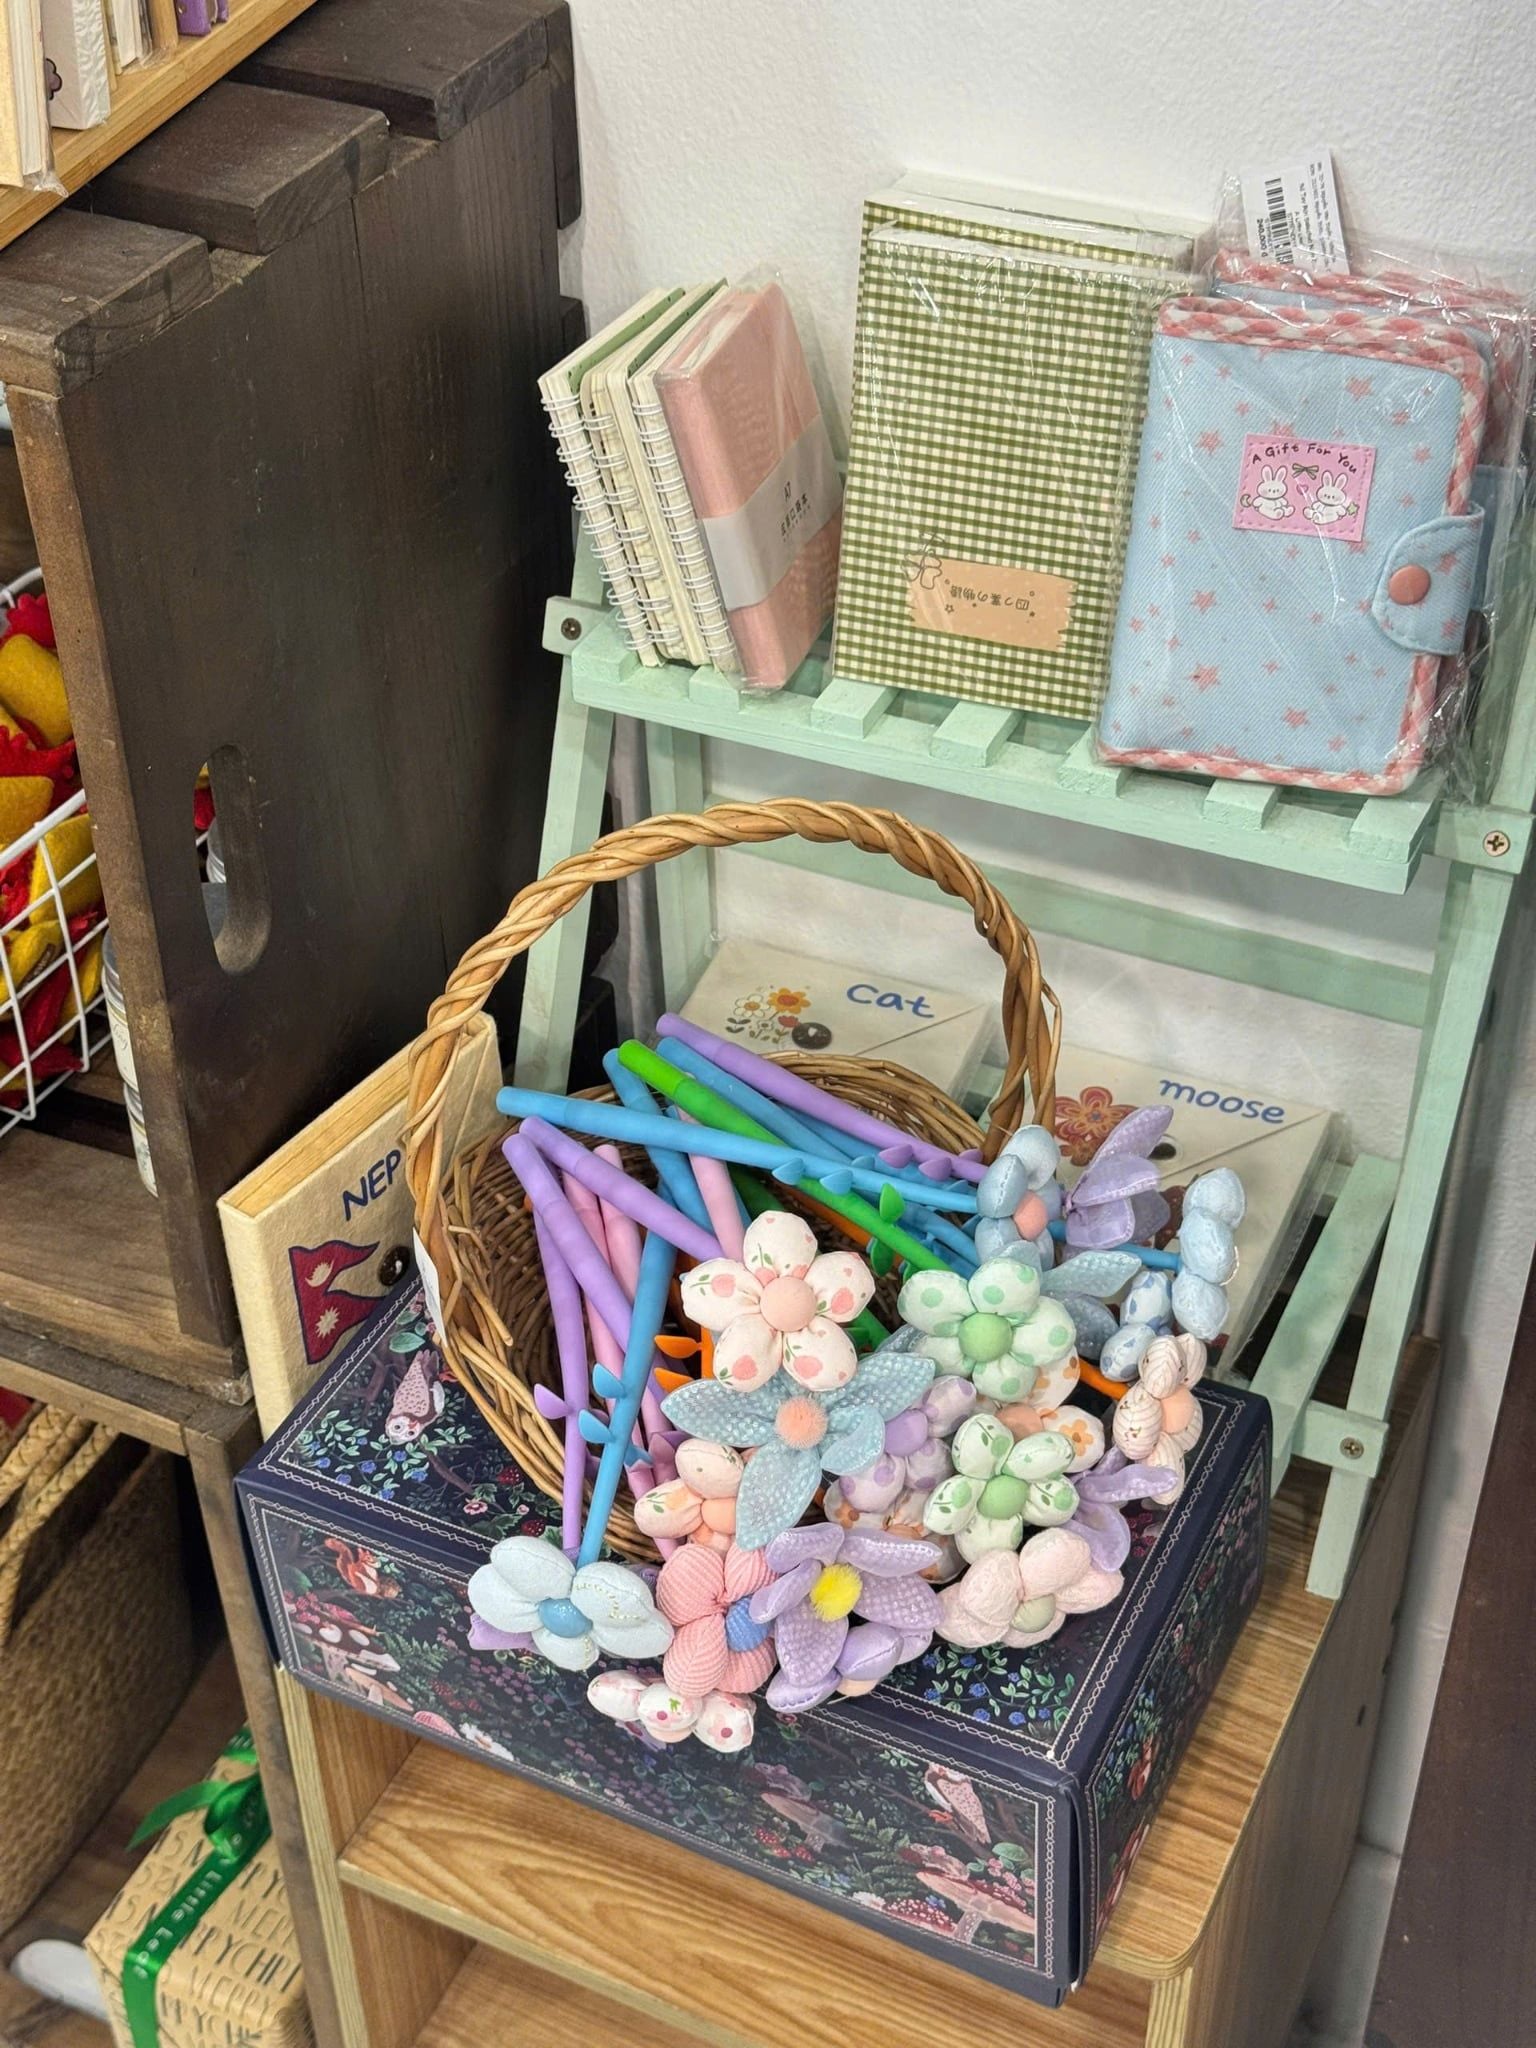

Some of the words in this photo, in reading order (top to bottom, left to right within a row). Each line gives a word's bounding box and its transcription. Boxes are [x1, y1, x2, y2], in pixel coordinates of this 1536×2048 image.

[1251, 454, 1262, 464] A
[1265, 443, 1300, 458] Gift
[1307, 443, 1331, 455] For
[1337, 453, 1358, 475] You
[1159, 1079, 1285, 1124] moose
[342, 1149, 402, 1222] NEP
